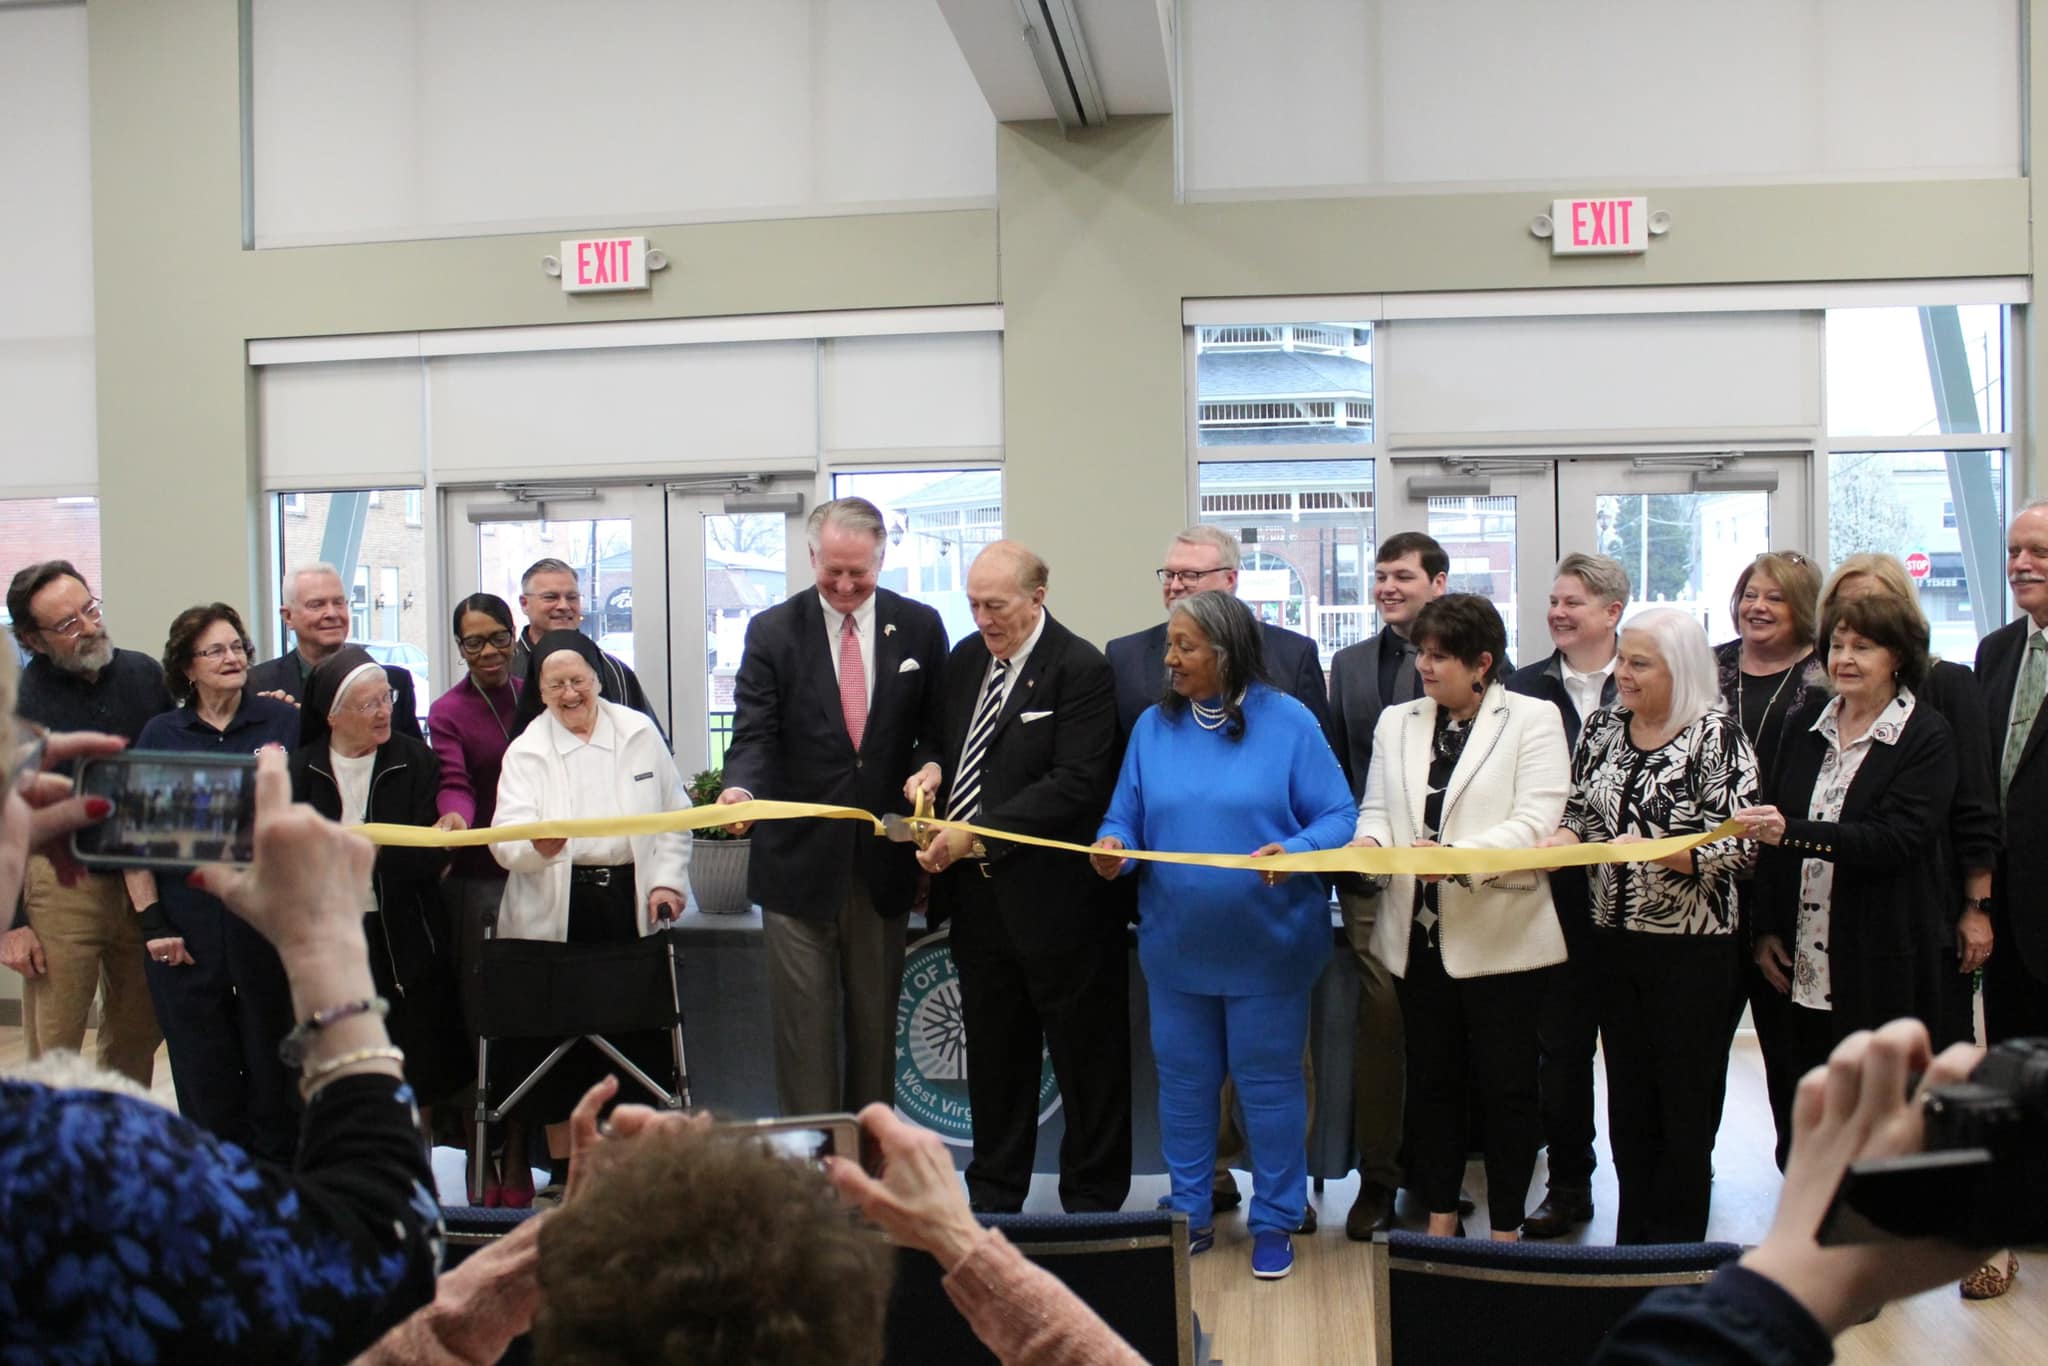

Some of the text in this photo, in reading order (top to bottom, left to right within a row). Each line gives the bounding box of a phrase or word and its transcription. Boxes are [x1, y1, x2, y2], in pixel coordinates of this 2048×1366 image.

[1572, 201, 1632, 246] EXIT
[577, 240, 632, 285] EXIT
[1905, 560, 1929, 571] STOP
[896, 964, 939, 1036] CITY OF
[901, 1067, 972, 1122] West Virg
